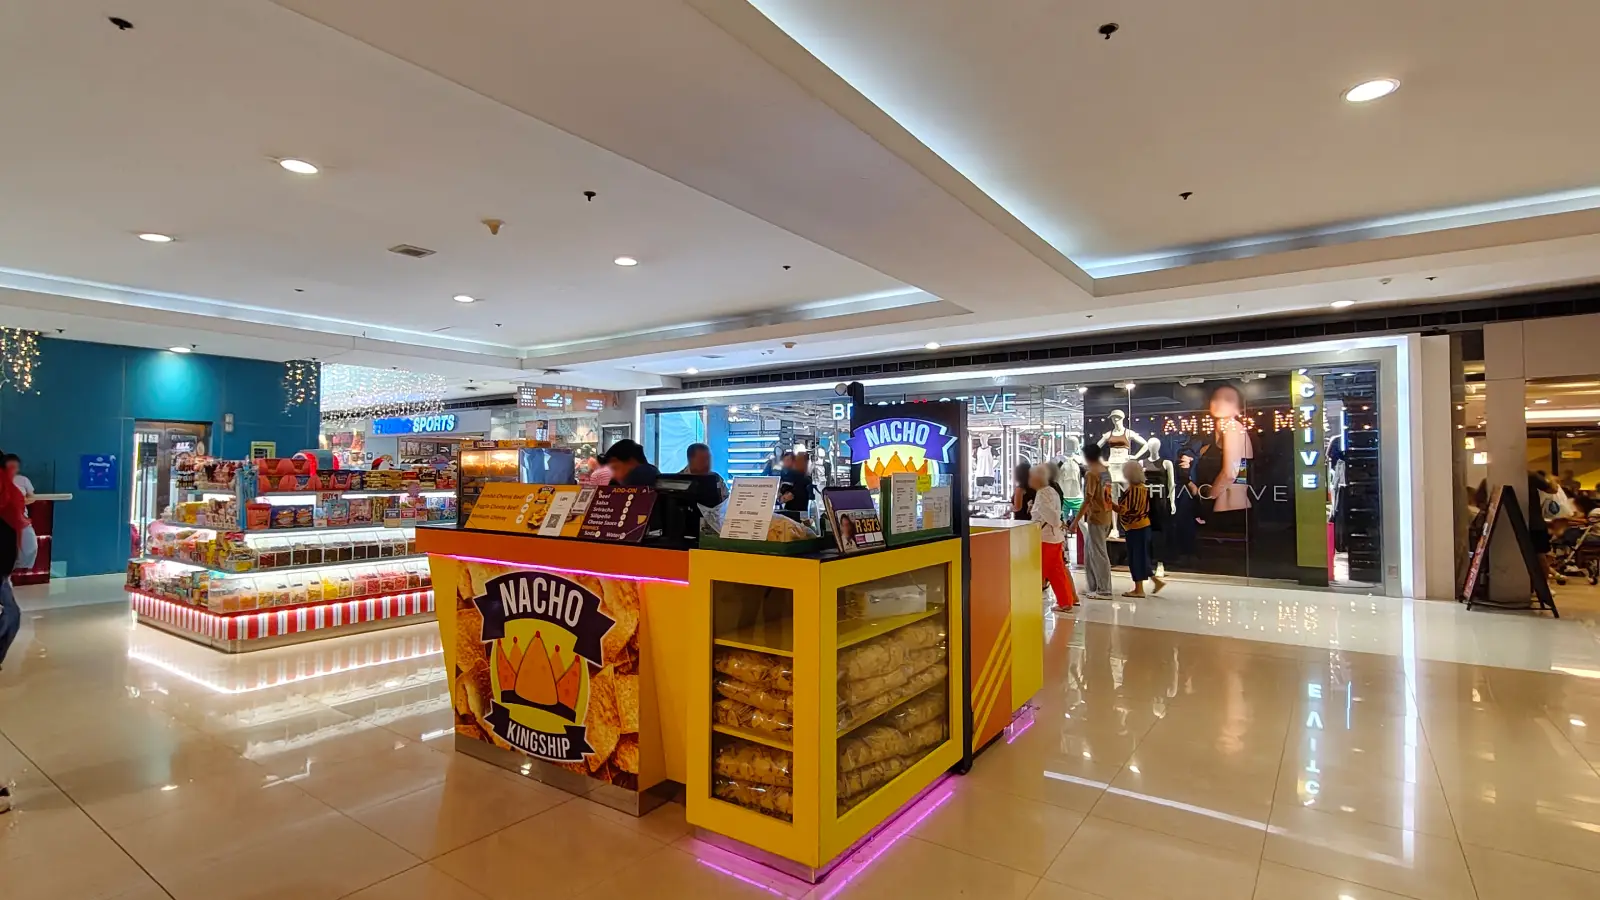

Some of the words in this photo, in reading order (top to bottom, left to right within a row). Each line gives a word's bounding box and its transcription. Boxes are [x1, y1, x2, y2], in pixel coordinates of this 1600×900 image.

[412, 414, 456, 433] SPORTS
[864, 420, 930, 448] NACHO
[1298, 369, 1319, 489] CTIVE
[499, 577, 583, 628] NACHO
[506, 720, 571, 759] KINGSHIP
